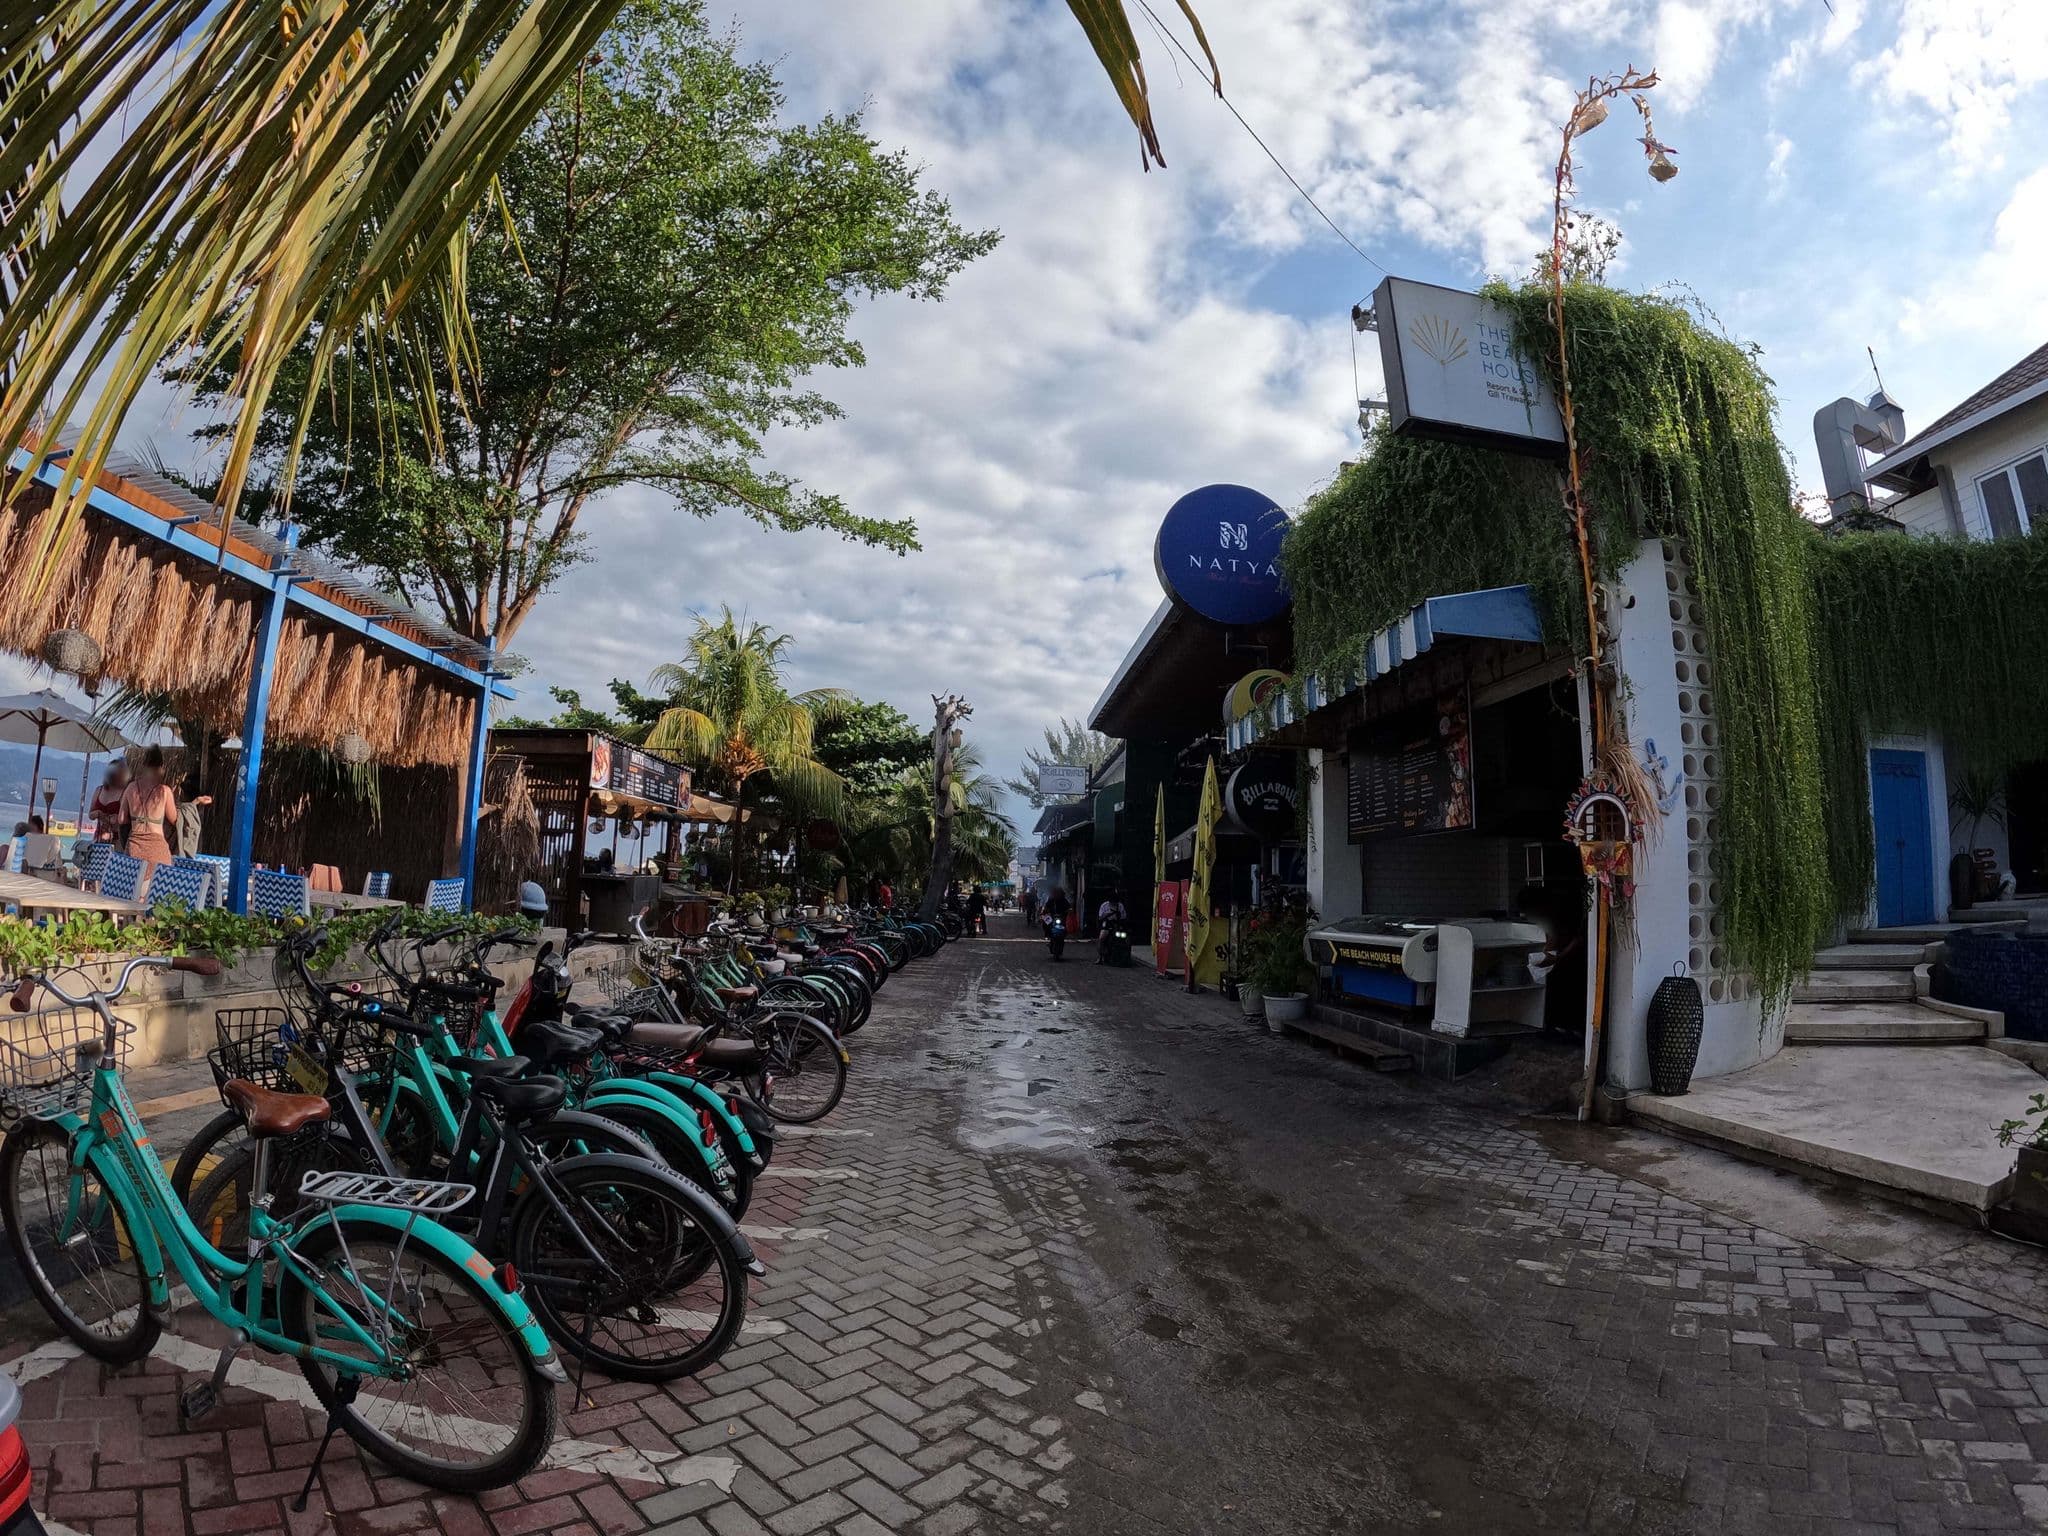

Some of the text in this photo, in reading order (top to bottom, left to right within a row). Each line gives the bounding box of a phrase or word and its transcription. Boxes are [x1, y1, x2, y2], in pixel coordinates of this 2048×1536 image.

[1476, 323, 1511, 344] THE
[1189, 555, 1277, 577] NATYA
[1339, 947, 1351, 958] THE
[1350, 949, 1370, 961] BEACH
[1370, 951, 1391, 963] HOUSE
